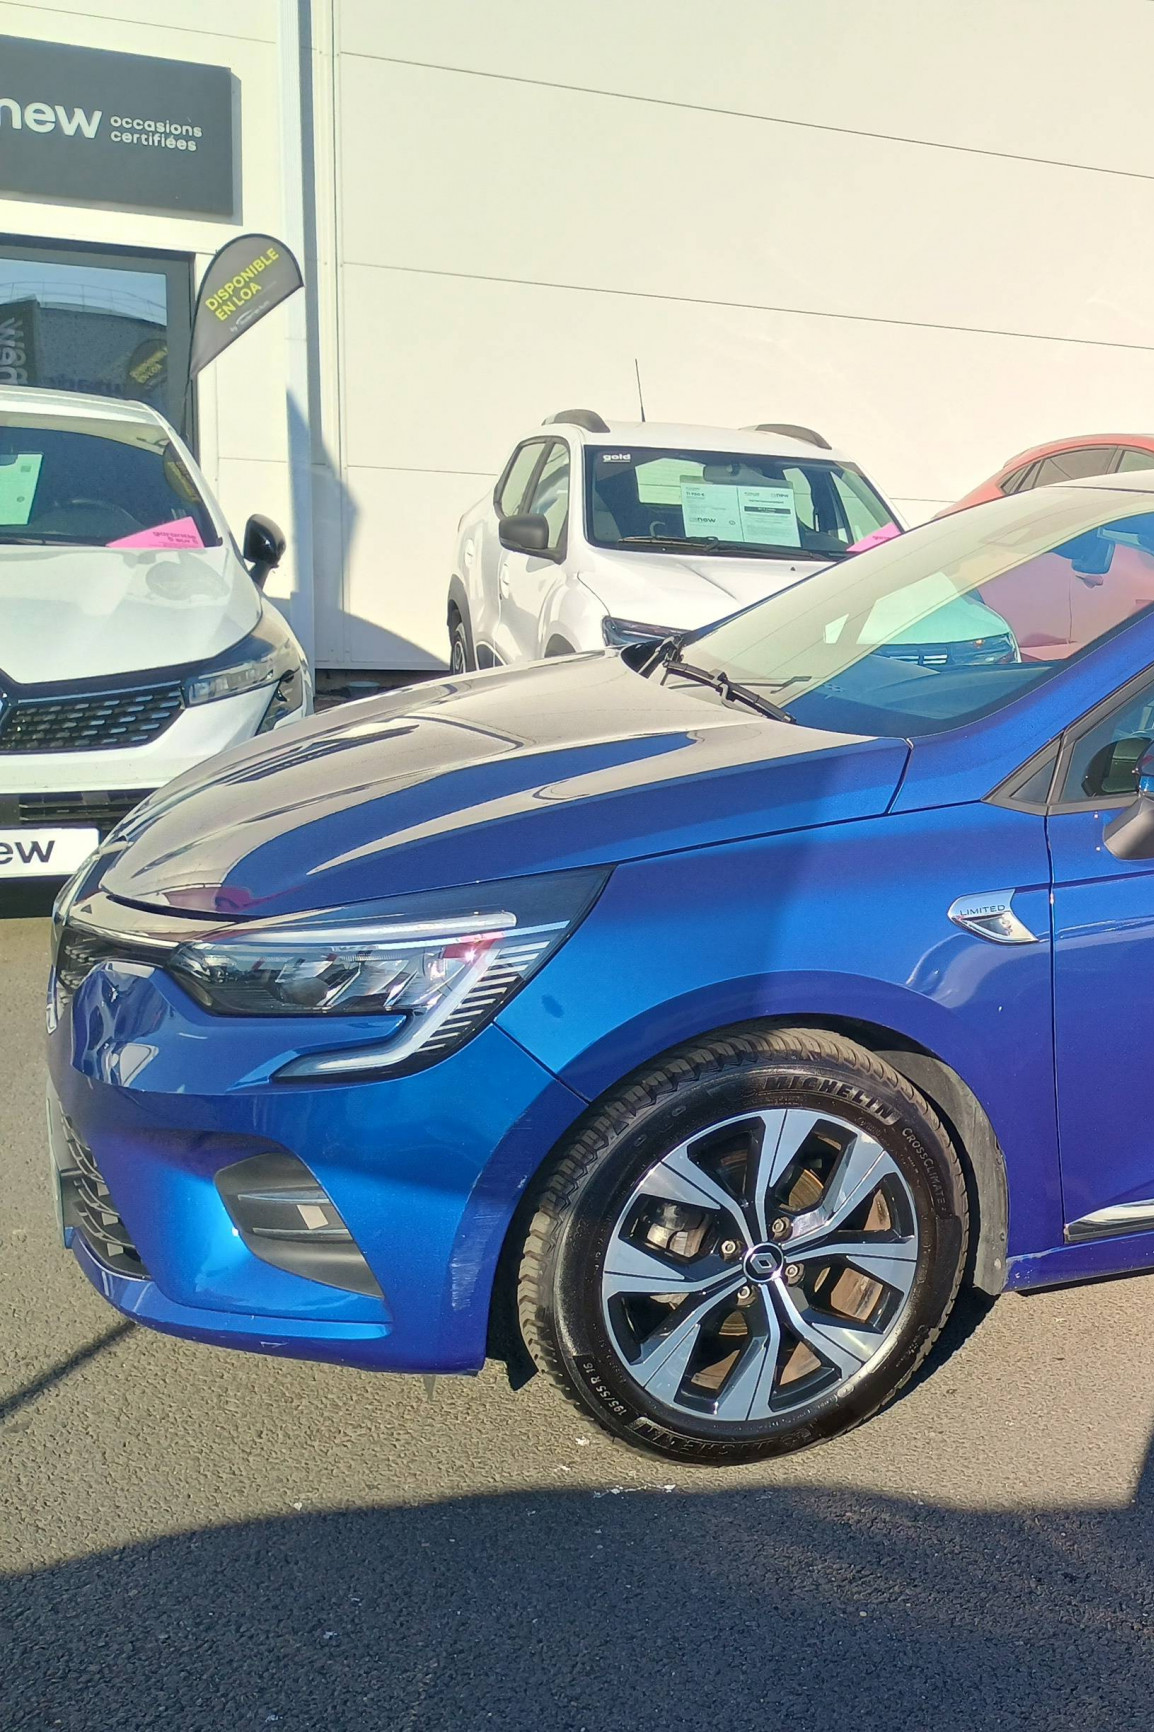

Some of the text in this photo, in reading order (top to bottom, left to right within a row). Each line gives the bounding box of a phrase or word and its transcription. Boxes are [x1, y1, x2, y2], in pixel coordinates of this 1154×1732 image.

[110, 115, 203, 138] occasions
[110, 131, 197, 152] certifiées
[205, 247, 279, 311] DISPONIBLE
[215, 301, 236, 321] EN
[233, 282, 262, 306] LOA
[602, 453, 631, 462] gold
[959, 904, 1006, 917] LIMITED
[764, 1076, 895, 1121] MICHELIN
[902, 1127, 946, 1205] CROSSCLIMATE
[590, 1376, 602, 1385] R
[595, 1384, 628, 1417] 195/55
